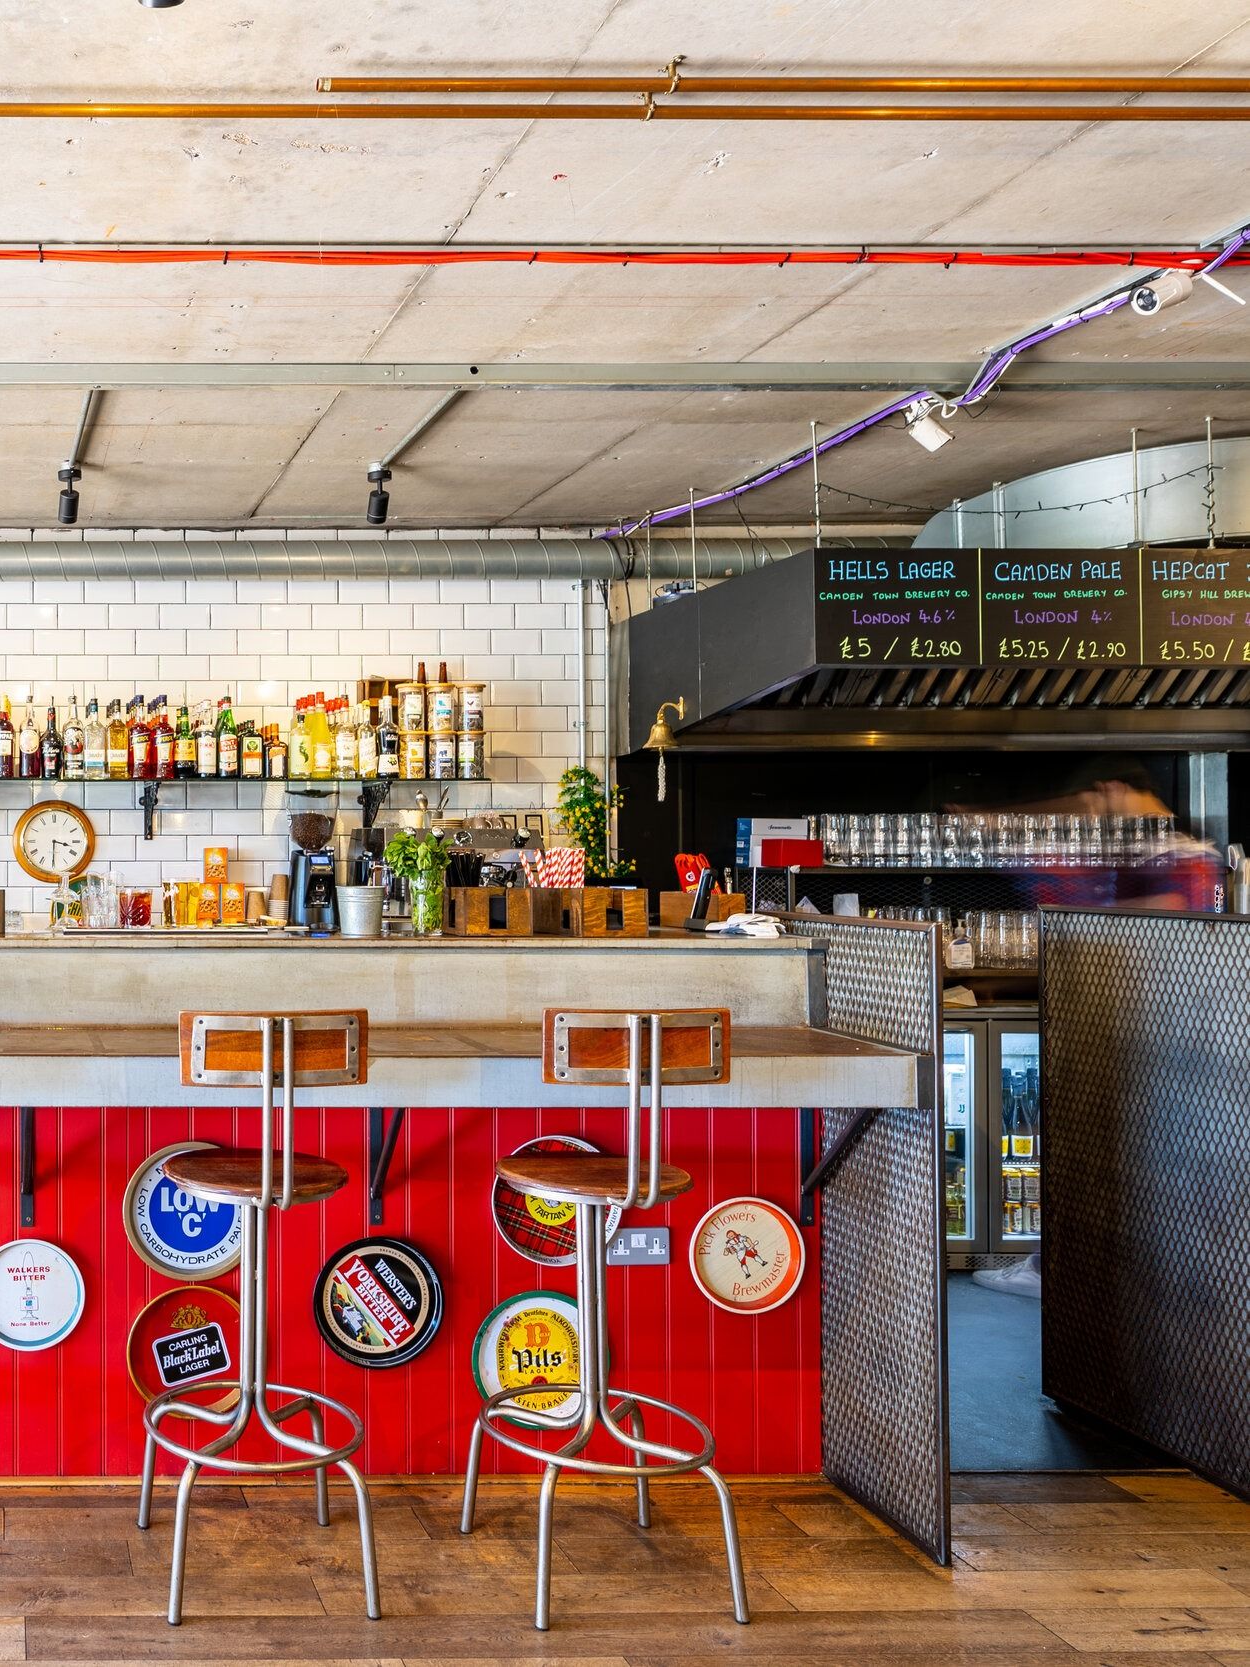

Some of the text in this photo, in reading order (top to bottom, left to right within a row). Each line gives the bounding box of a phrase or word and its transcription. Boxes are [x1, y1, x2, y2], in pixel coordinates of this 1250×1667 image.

[829, 560, 956, 580] HELLS LAGER
[994, 560, 1122, 581] CAMDEN PALE
[1152, 560, 1230, 581] HEPCAT
[819, 592, 864, 601] CAMDEN
[873, 592, 899, 600] TOWN
[905, 590, 950, 599] BREWERY
[986, 592, 1024, 600] CAMDEN
[1033, 591, 1056, 599] TOWN
[1064, 590, 1107, 599] BREWERY
[1162, 589, 1192, 599] GIPSY
[1200, 590, 1218, 599] HILL
[852, 610, 910, 625] LONDON
[1014, 609, 1112, 625] LONDON 4%
[1171, 611, 1235, 626] LONDON
[839, 636, 871, 659] £5
[910, 637, 962, 658] £2.80
[999, 637, 1049, 658] £5.25
[1077, 640, 1126, 659] £2.90
[1159, 640, 1215, 660] £5.50
[137, 1188, 149, 1218] LOW
[160, 1187, 220, 1213] LOW
[534, 1205, 566, 1221] TARTAN
[698, 1210, 757, 1255] Pick Flowers
[140, 1223, 228, 1265] CARBOHYDRATE
[7, 1266, 51, 1274] WALKERS
[13, 1274, 46, 1282] BITTER
[732, 1250, 785, 1296] Brewmaster
[374, 1258, 417, 1310] WEBSTER'S
[344, 1258, 411, 1339] YORKSHIRE
[355, 1284, 388, 1322] BITTER
[169, 1334, 208, 1352] CARLING
[163, 1341, 221, 1369] Black Label
[512, 1347, 562, 1373] Pils
[179, 1359, 210, 1374] LAGER
